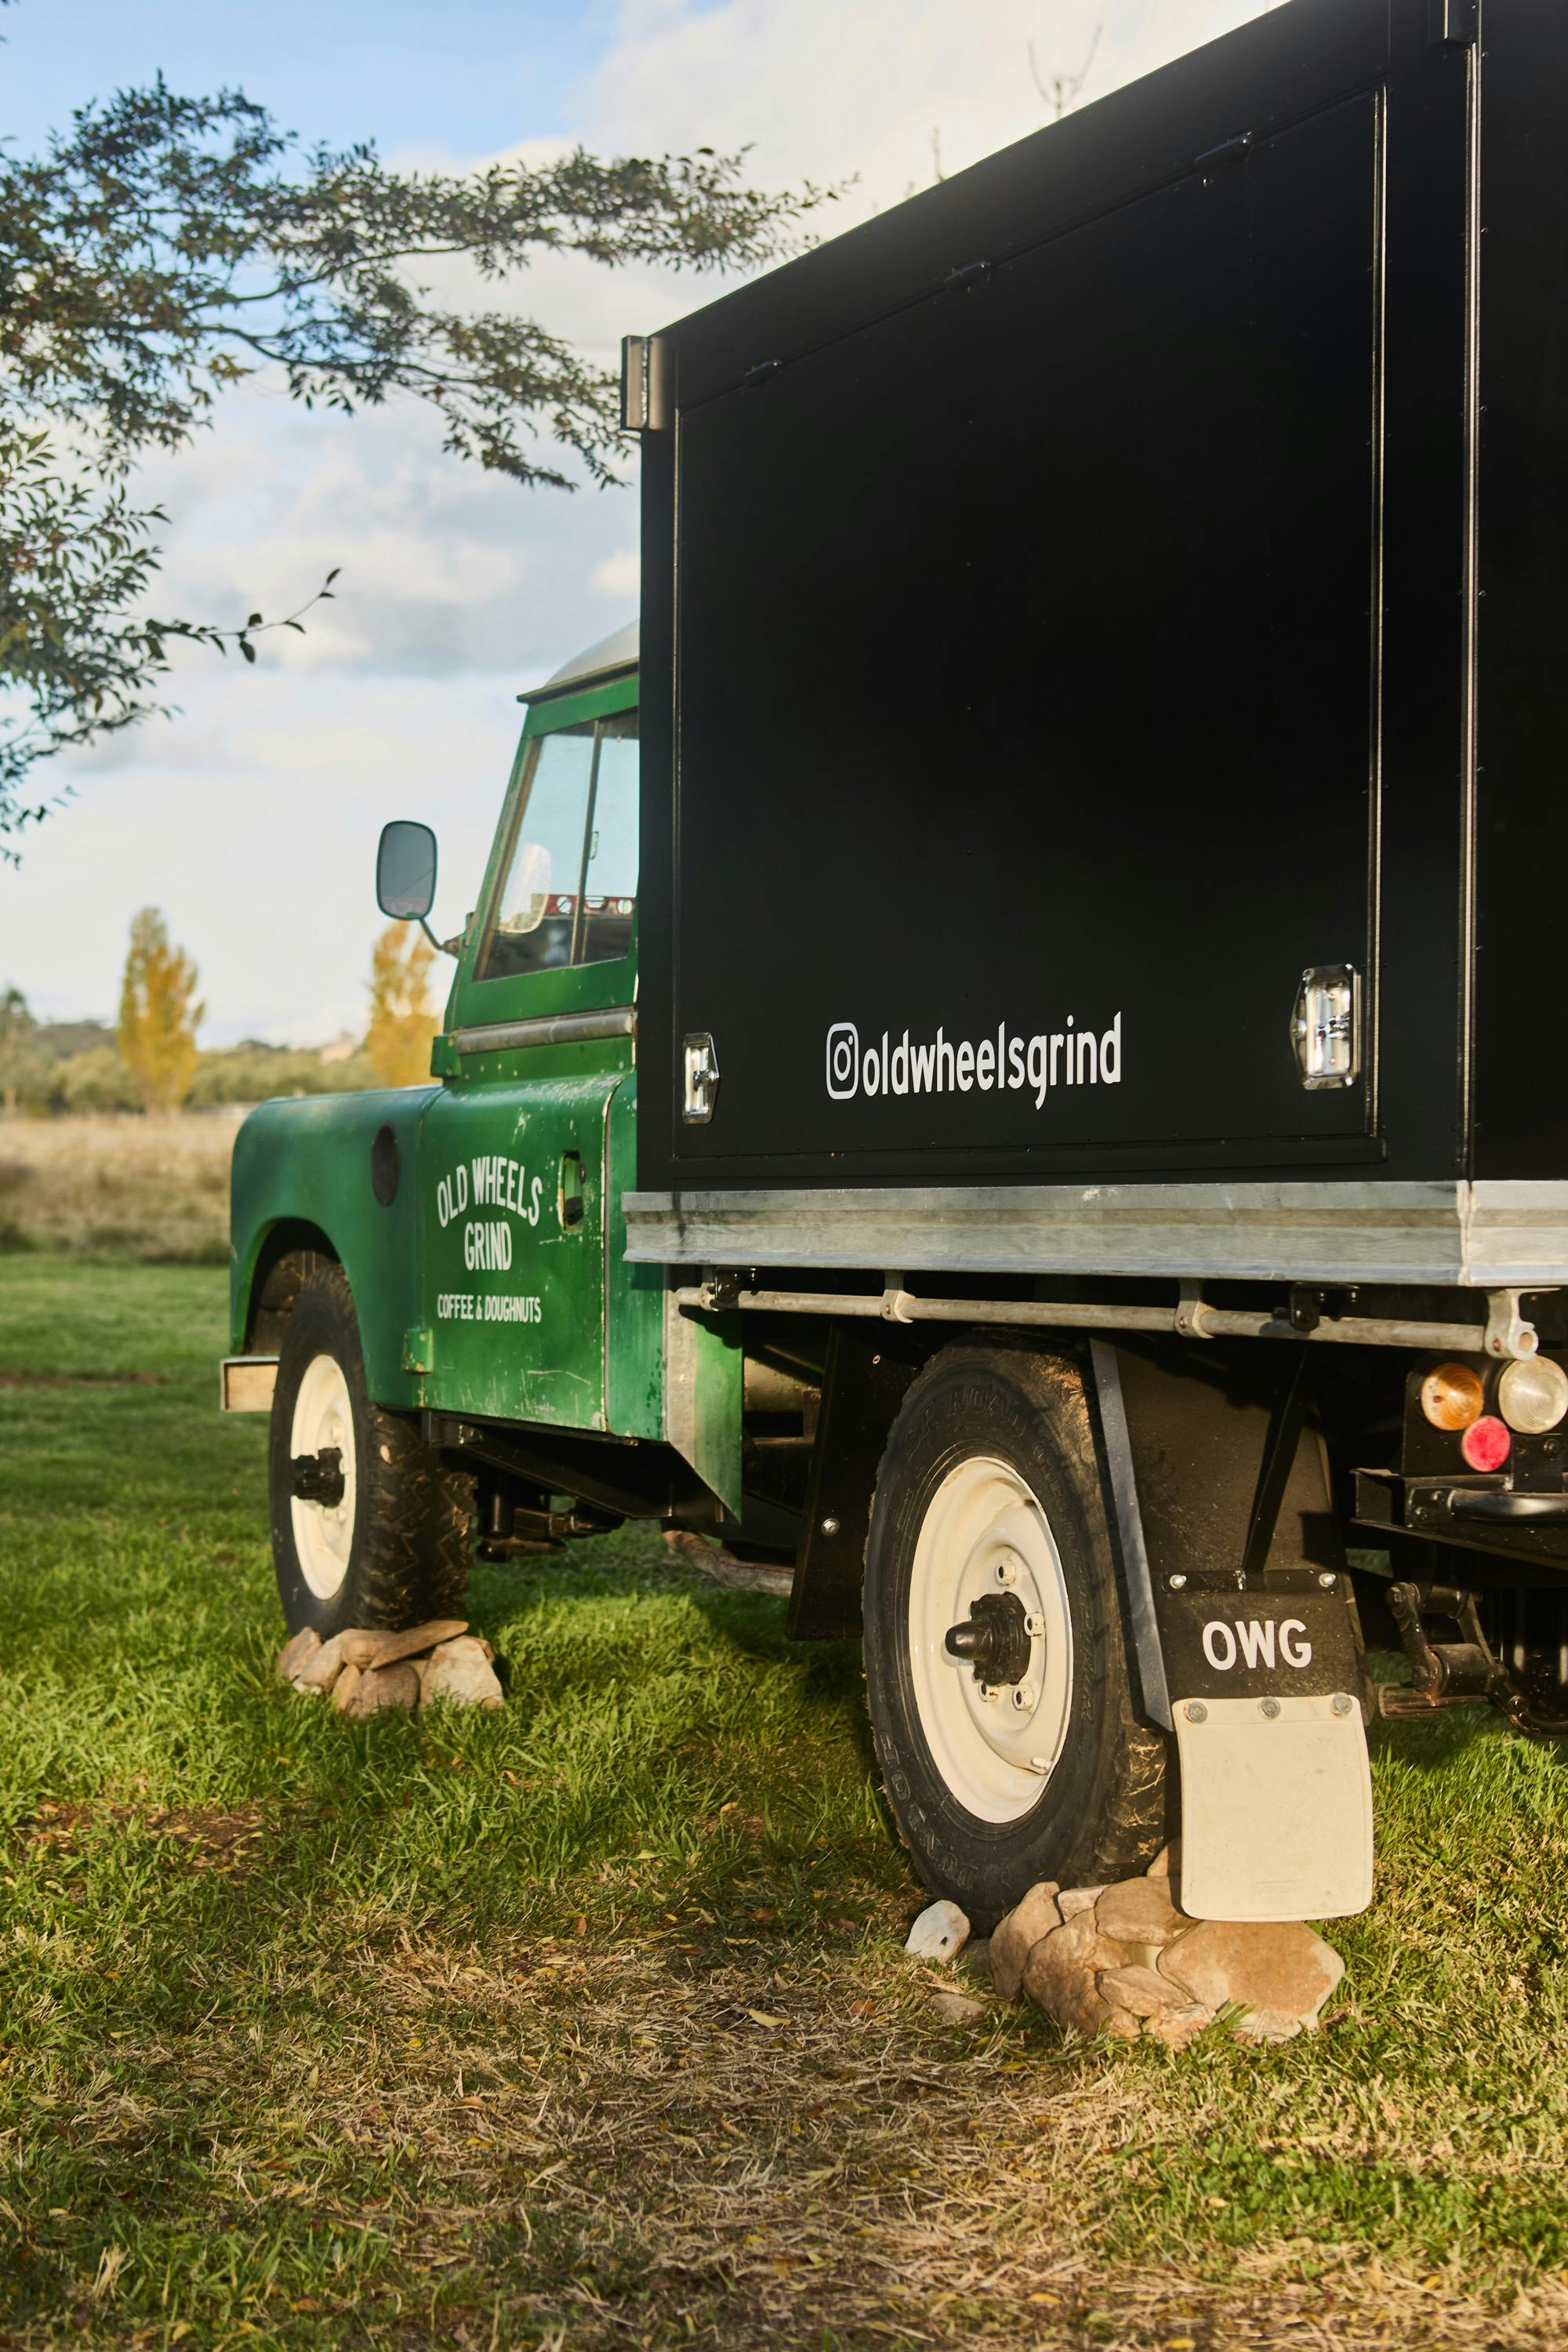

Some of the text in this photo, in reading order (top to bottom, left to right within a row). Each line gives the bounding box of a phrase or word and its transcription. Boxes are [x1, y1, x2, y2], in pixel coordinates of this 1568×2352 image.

[862, 1011, 1122, 1111] oldwheelsgrind
[437, 1156, 543, 1228] OLD WHEELS
[464, 1221, 512, 1271] GRIND
[437, 1294, 542, 1323] COFFEE & DOUGHNUTS
[1202, 1618, 1312, 1671] OWG
[879, 1731, 980, 1891] DUNLOP
